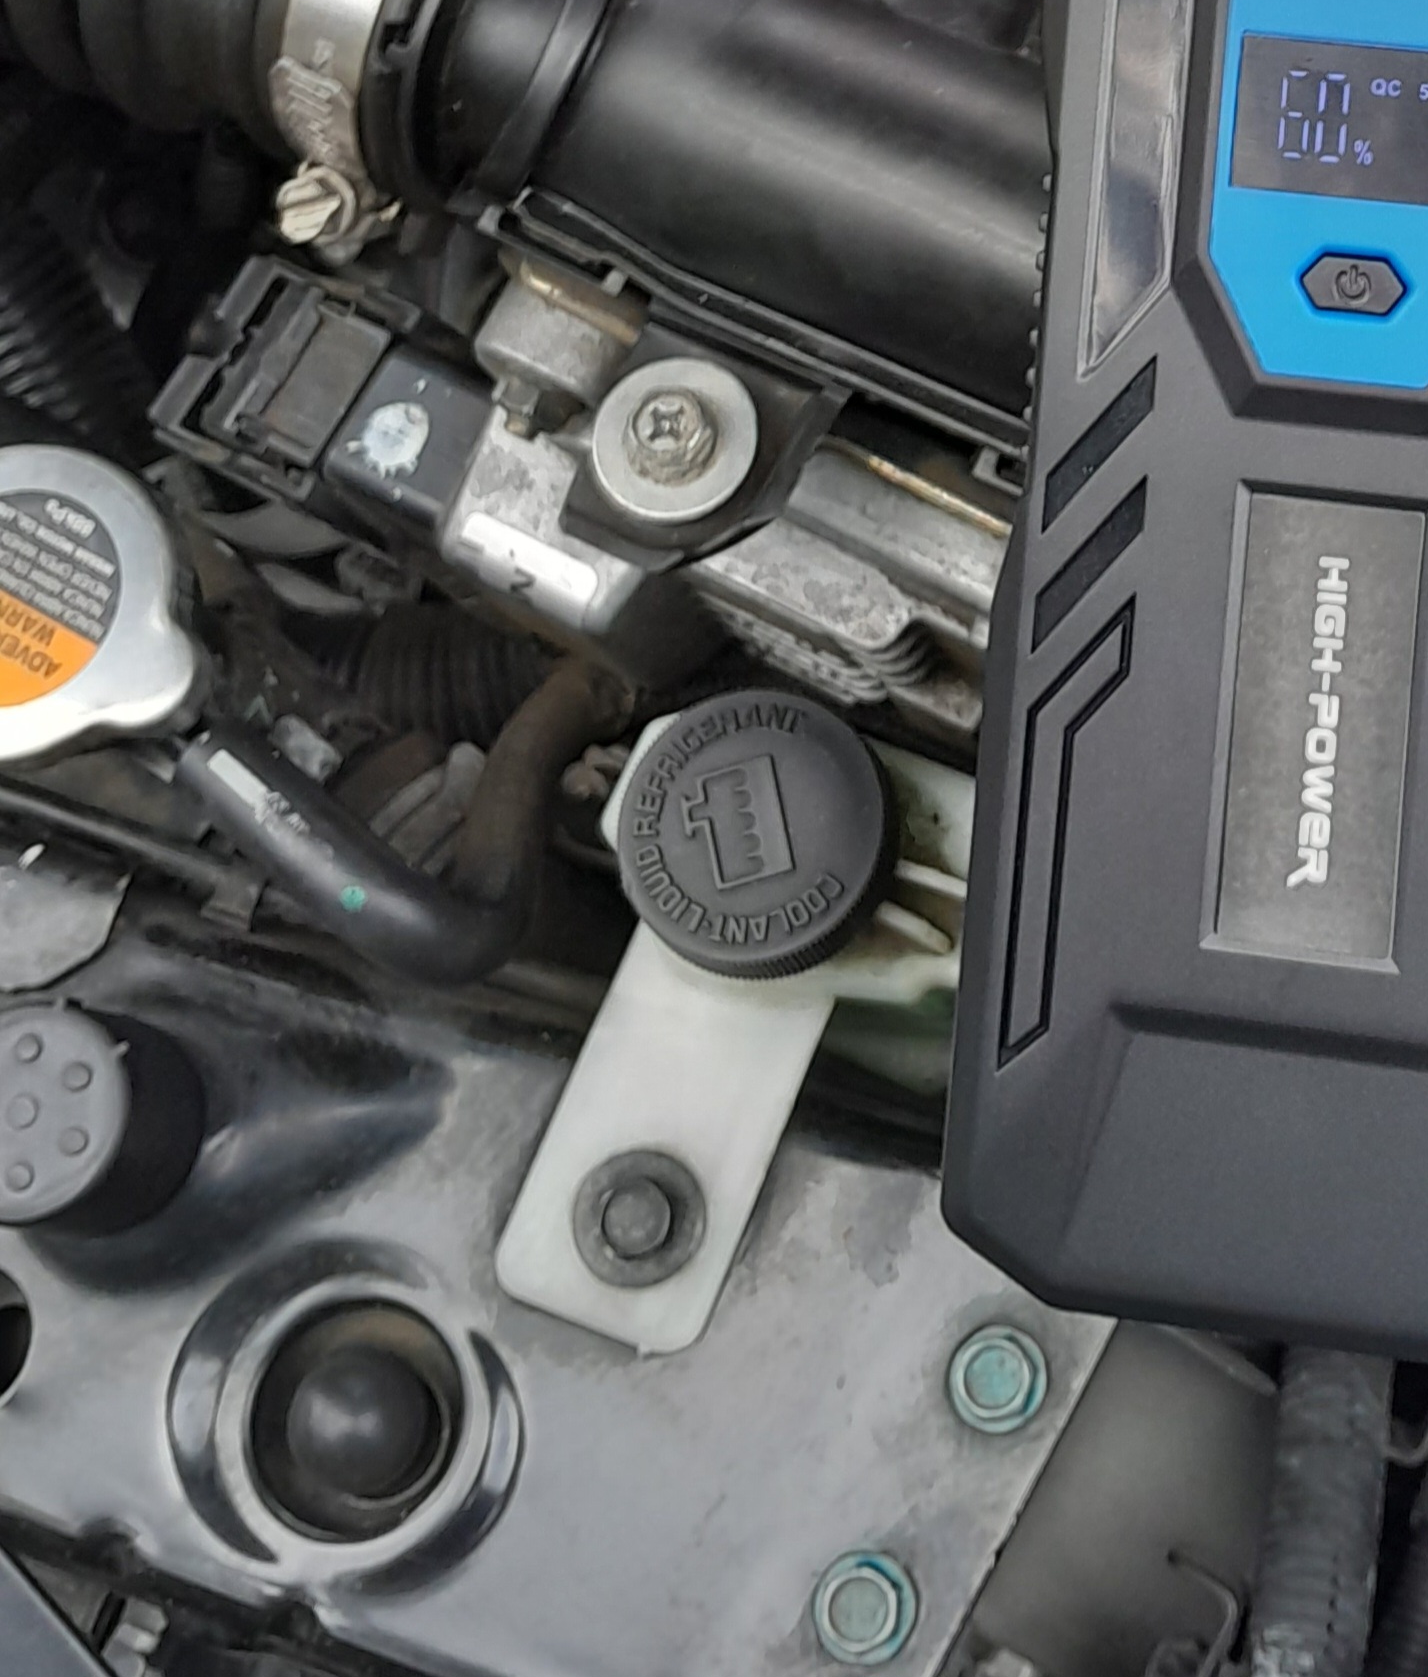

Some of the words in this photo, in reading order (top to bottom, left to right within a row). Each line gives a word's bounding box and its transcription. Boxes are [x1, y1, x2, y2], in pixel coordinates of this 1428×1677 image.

[1278, 70, 1374, 165] 60%
[1370, 78, 1401, 98] QC
[1285, 556, 1349, 888] HIGH-POWER
